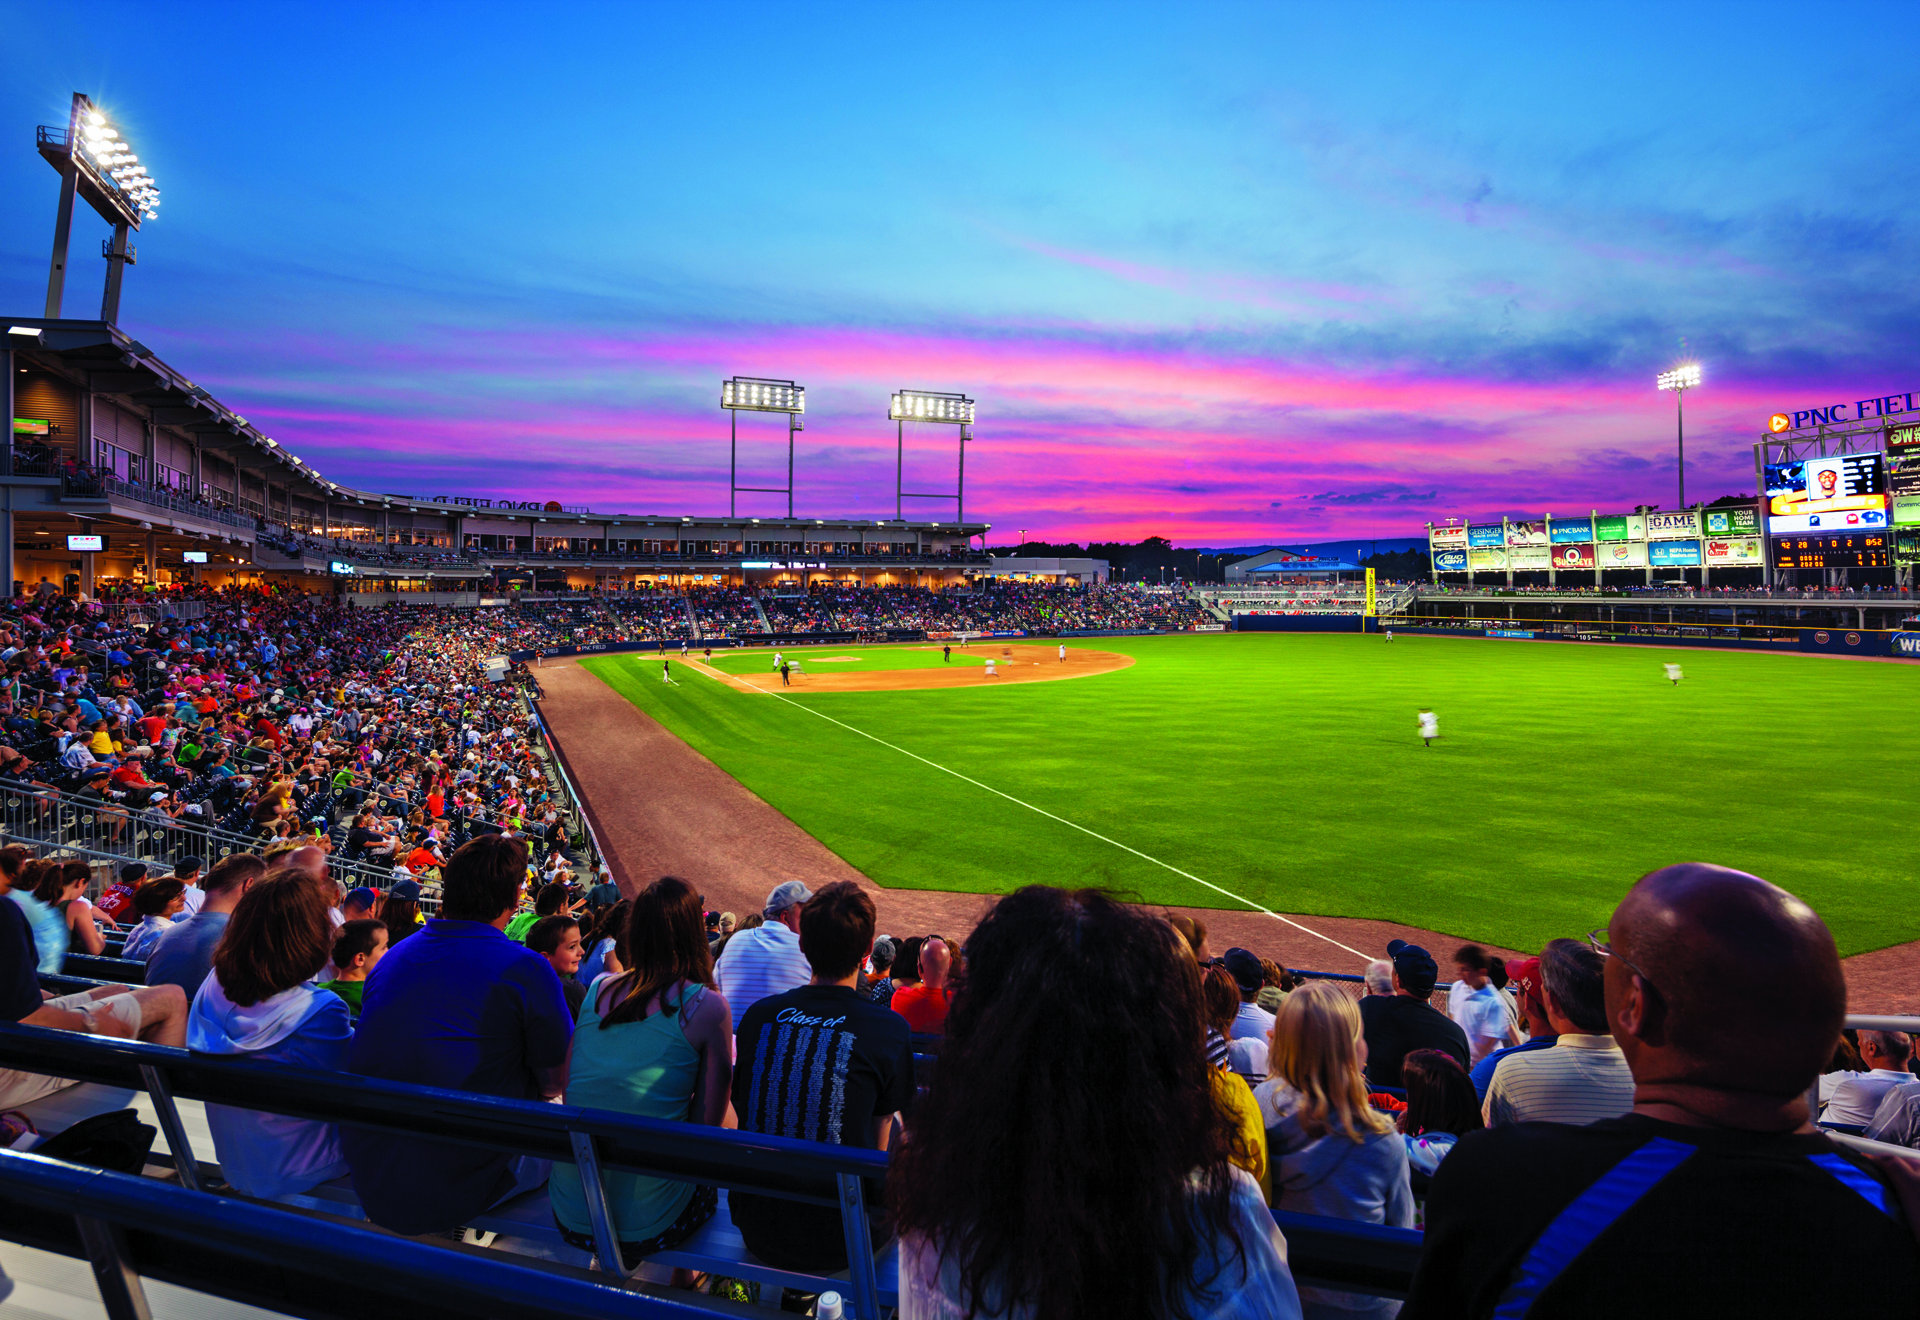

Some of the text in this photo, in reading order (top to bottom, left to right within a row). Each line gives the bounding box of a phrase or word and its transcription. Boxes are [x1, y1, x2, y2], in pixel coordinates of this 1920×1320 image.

[1792, 404, 1848, 428] PNC
[1653, 515, 1695, 526] GAME
[1798, 541, 1808, 549] 28
[1831, 539, 1837, 547] 0
[1847, 539, 1853, 547] 2
[1553, 557, 1593, 566] BULLSEYE
[776, 1007, 846, 1028] Class of
